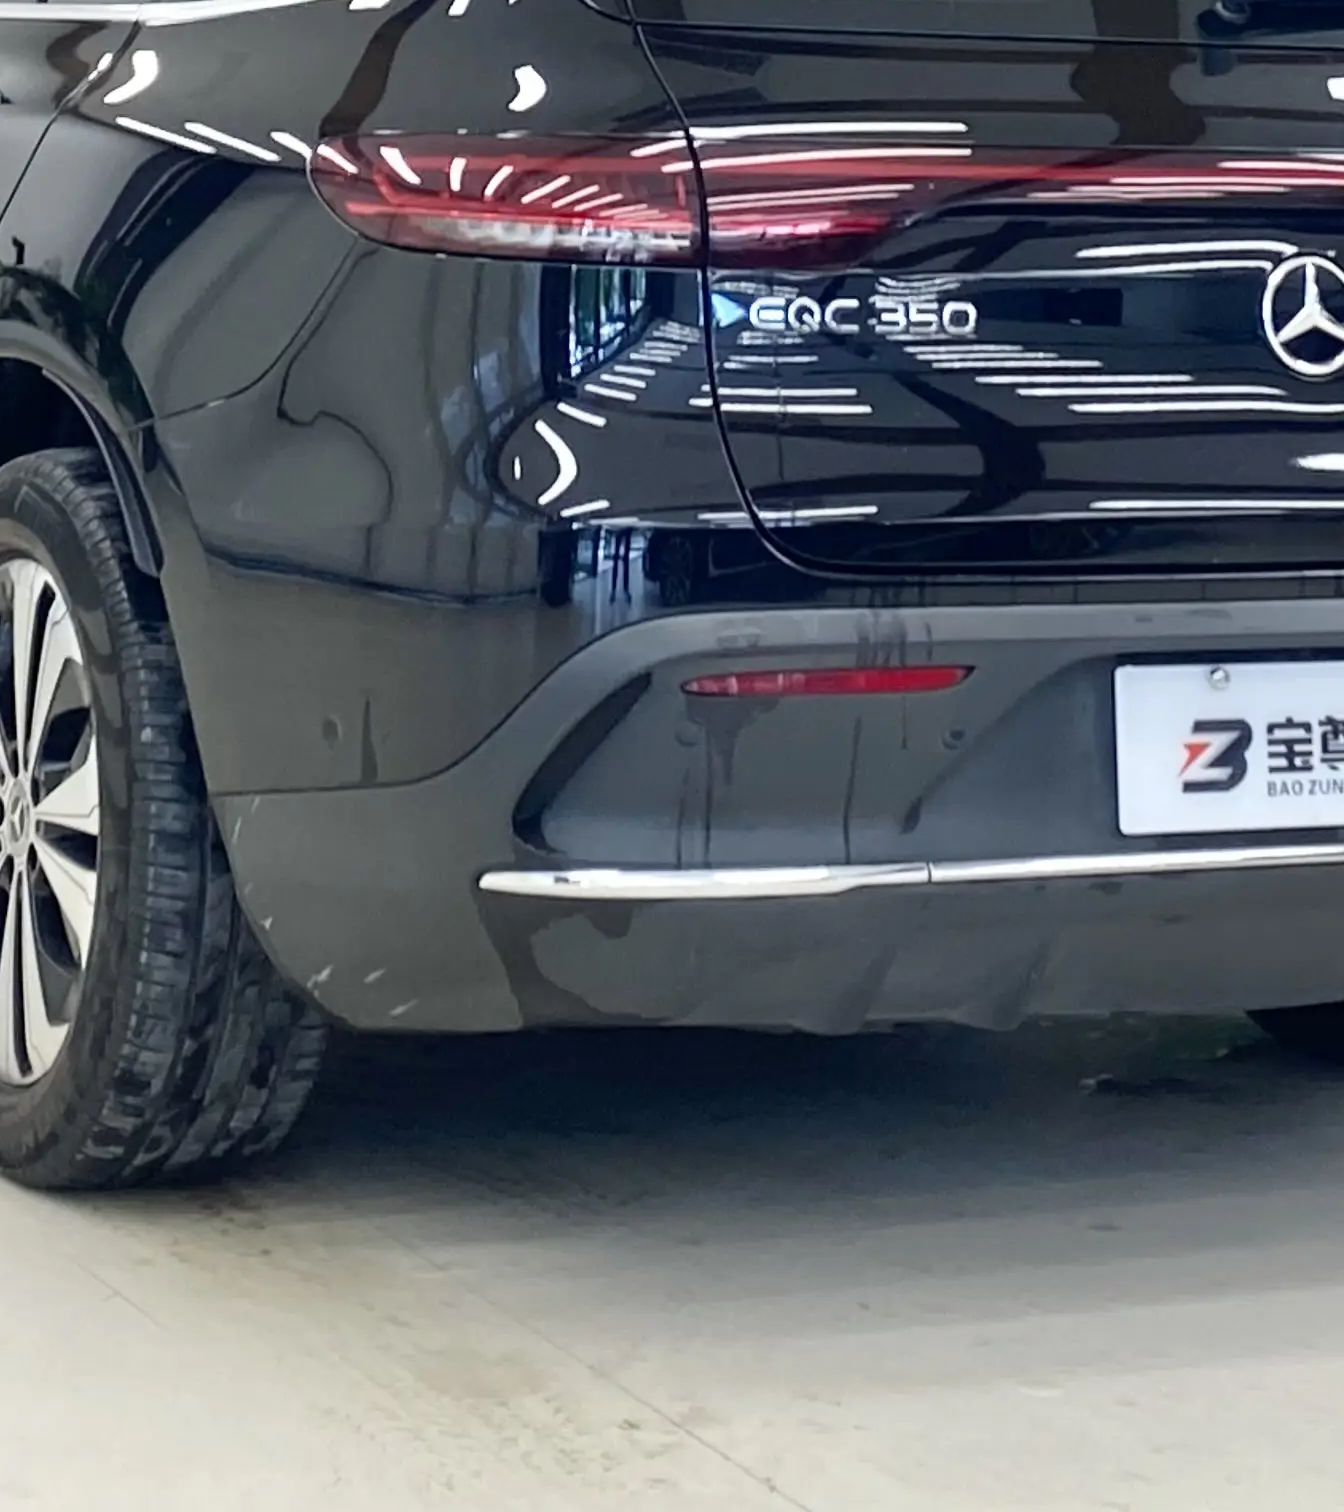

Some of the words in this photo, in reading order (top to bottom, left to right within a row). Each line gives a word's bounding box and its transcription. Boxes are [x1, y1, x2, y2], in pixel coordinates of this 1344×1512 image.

[749, 296, 860, 333] EQC
[874, 298, 977, 335] 350
[1267, 780, 1304, 797] BAO
[1308, 778, 1344, 796] ZUN
